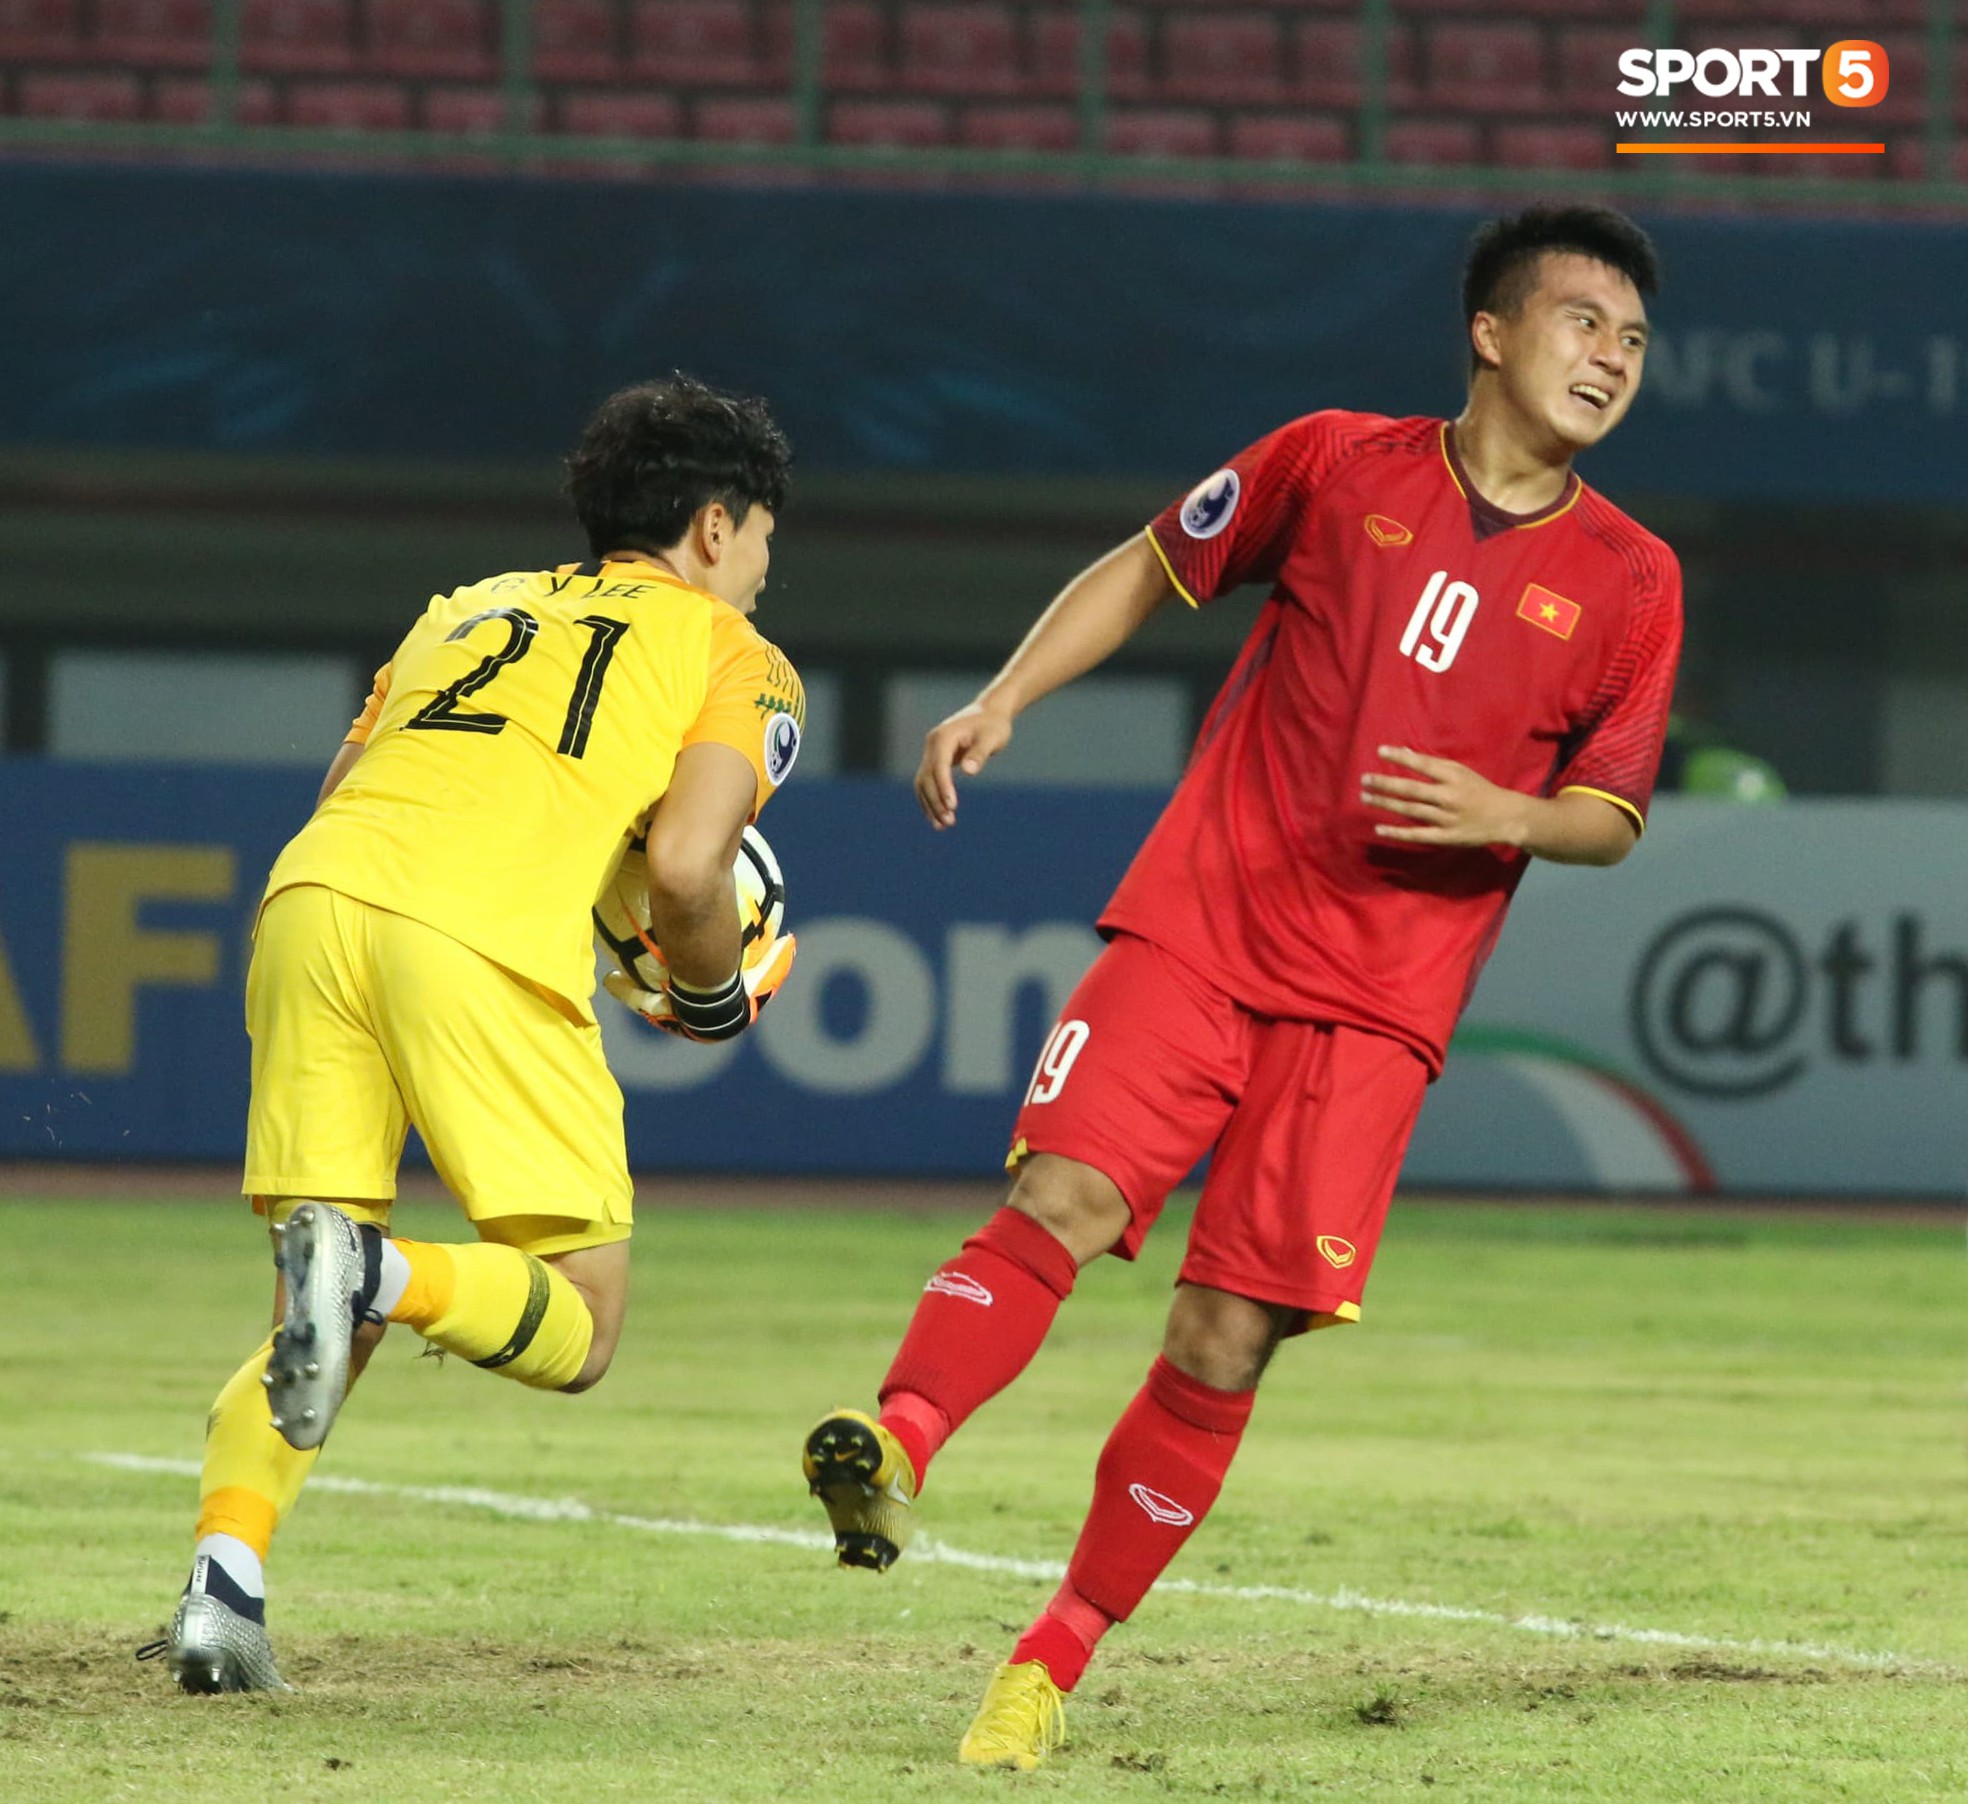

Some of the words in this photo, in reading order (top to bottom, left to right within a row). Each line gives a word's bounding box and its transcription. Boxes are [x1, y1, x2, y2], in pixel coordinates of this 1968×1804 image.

[582, 578, 656, 599] LEE
[1399, 570, 1479, 673] 19
[400, 607, 630, 759] 21
